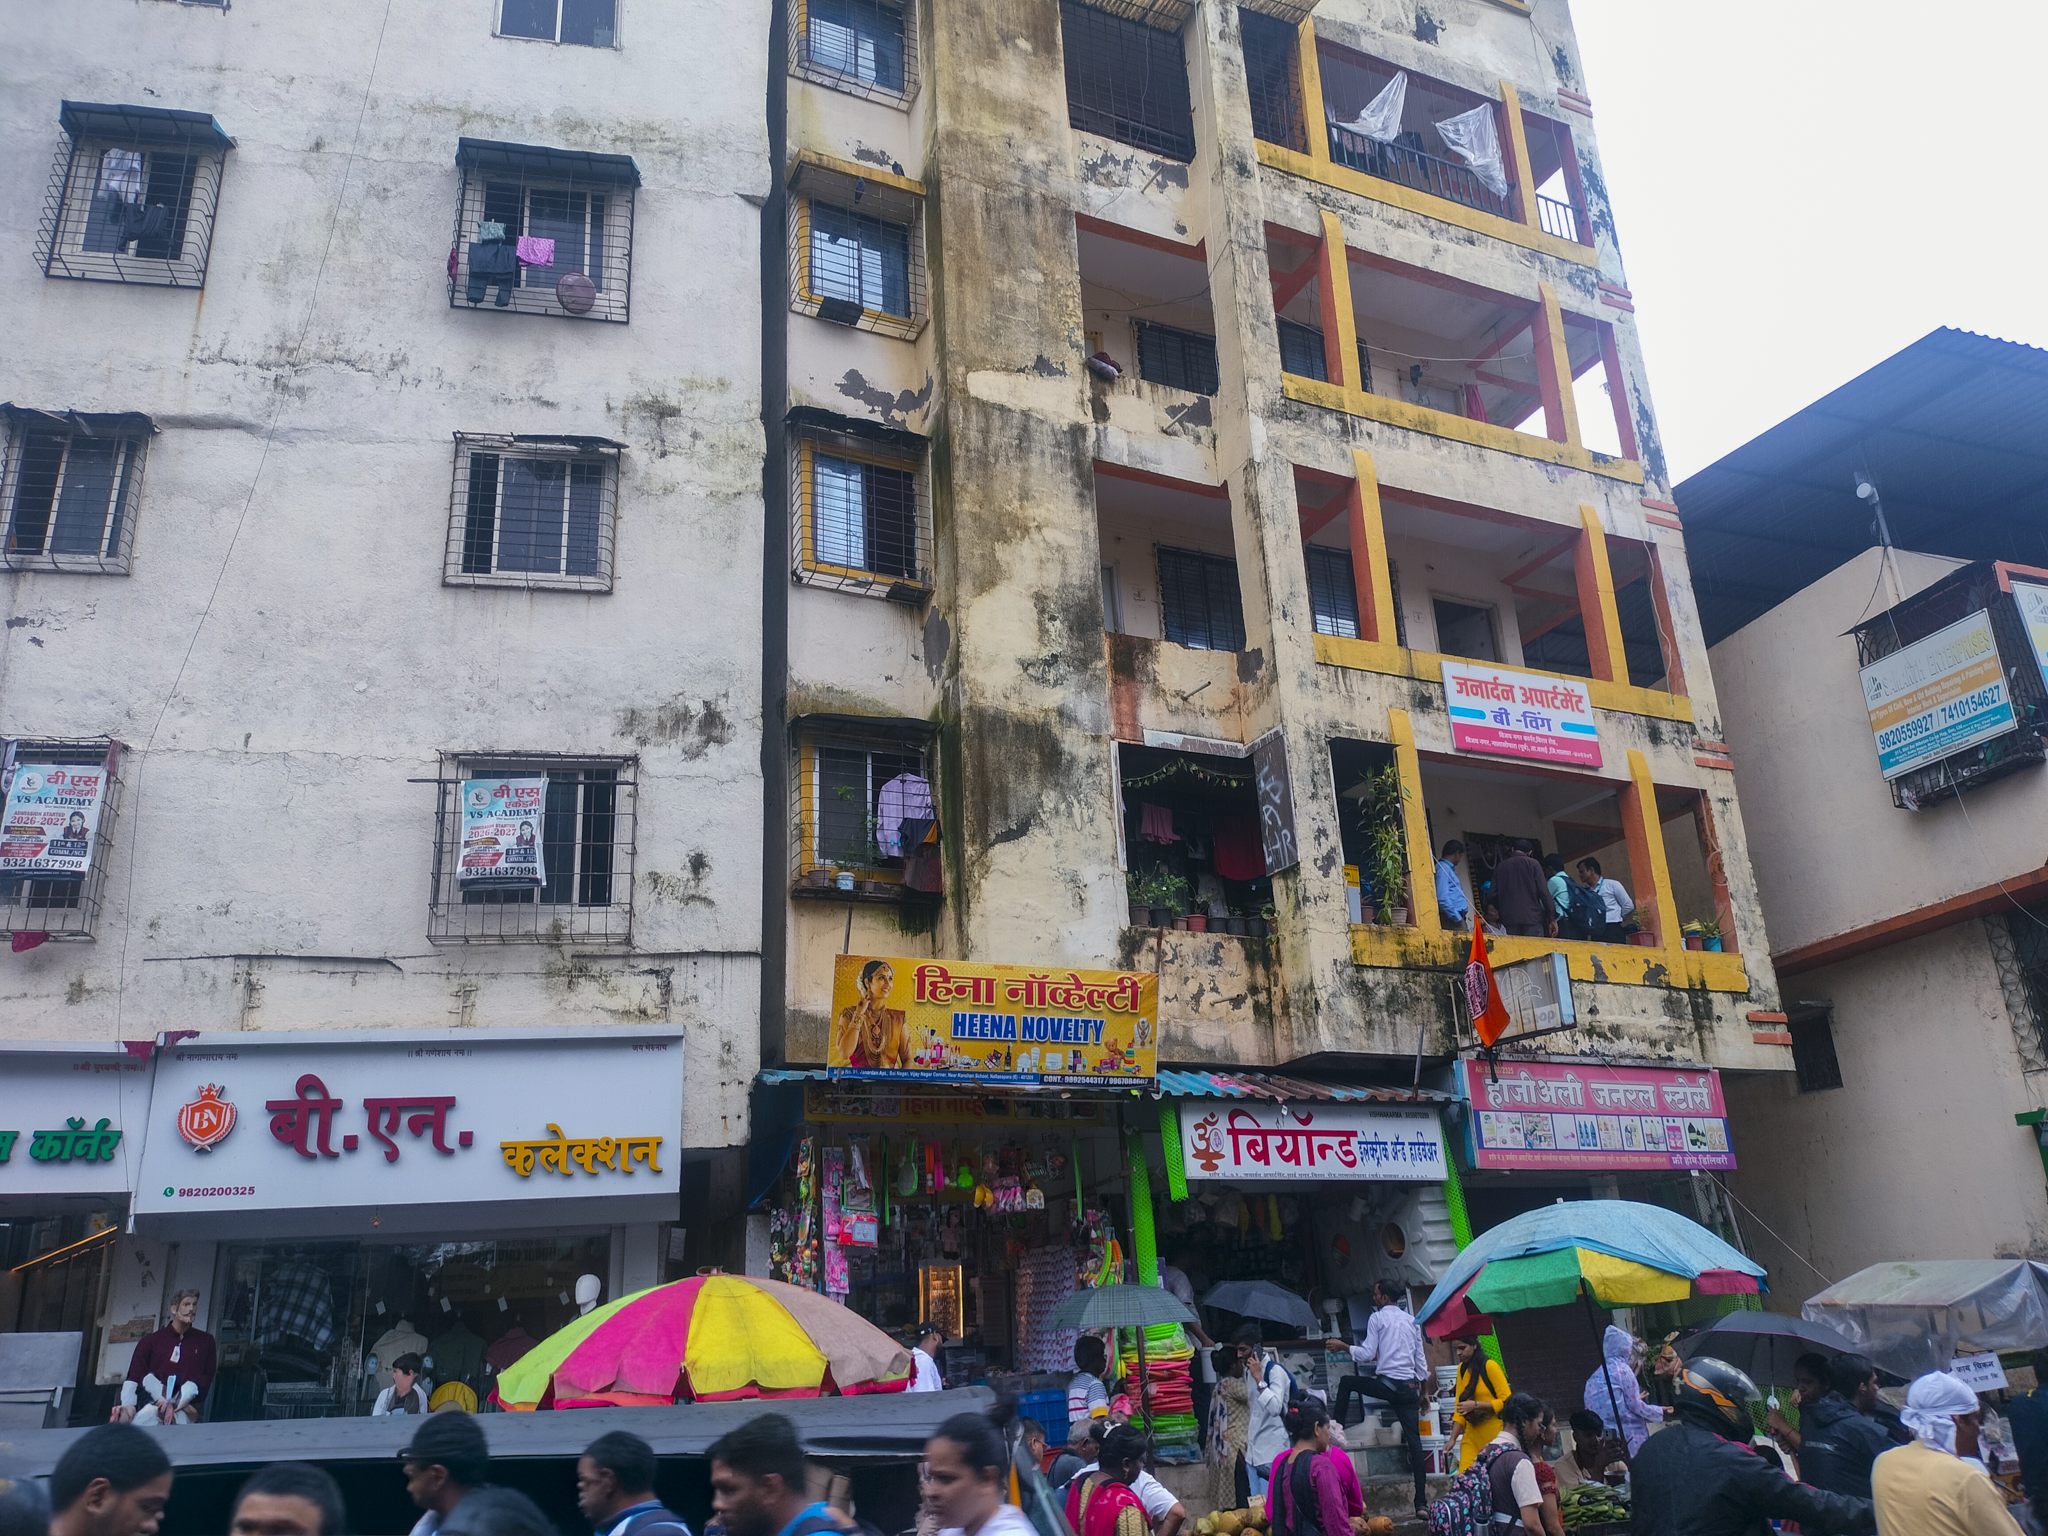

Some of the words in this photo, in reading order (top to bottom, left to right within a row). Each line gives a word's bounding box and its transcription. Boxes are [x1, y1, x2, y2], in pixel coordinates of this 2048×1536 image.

[1966, 668, 1984, 681] Painting
[1452, 675, 1516, 704] जनार्दन
[1519, 685, 1585, 713] अपार्टमेंट
[1490, 707, 1511, 726] बी
[1879, 713, 1934, 750] 9820559927
[1941, 684, 2001, 724] 7410154627
[46, 771, 67, 785] वी
[70, 775, 101, 787] एस
[57, 786, 98, 797] एकेडमी
[493, 784, 511, 798] वी
[514, 787, 541, 798] एस
[17, 795, 32, 804] VS
[35, 797, 94, 807] ACADEMY
[470, 811, 483, 819] VS
[486, 808, 538, 818] ACADEMY
[10, 816, 66, 826] 2026-2027
[468, 828, 517, 839] 2026-2027
[3, 858, 83, 869] 9321637998
[465, 866, 538, 877] 9321637998
[912, 963, 998, 1005] हिना
[1004, 972, 1142, 1012] नॉव्हेल्टी
[952, 1012, 1018, 1040] HEENA
[1021, 1015, 1105, 1043] NOVELTY
[1589, 1082, 1657, 1109] जनरल
[1661, 1077, 1711, 1111] स्टोर्स
[192, 1108, 220, 1129] BN
[1368, 1110, 1402, 1118] VISHWAKARMA
[30, 1116, 123, 1162] कॉर्नर
[1226, 1108, 1358, 1168] बियॉन्ड
[500, 1123, 663, 1177] कलेक्शन
[1671, 1154, 1682, 1165] फ्री
[1684, 1154, 1697, 1165] होम
[1699, 1154, 1728, 1165] डिलिवरी
[179, 1186, 256, 1198] 9820200325
[1973, 1360, 1994, 1371] चिकन
